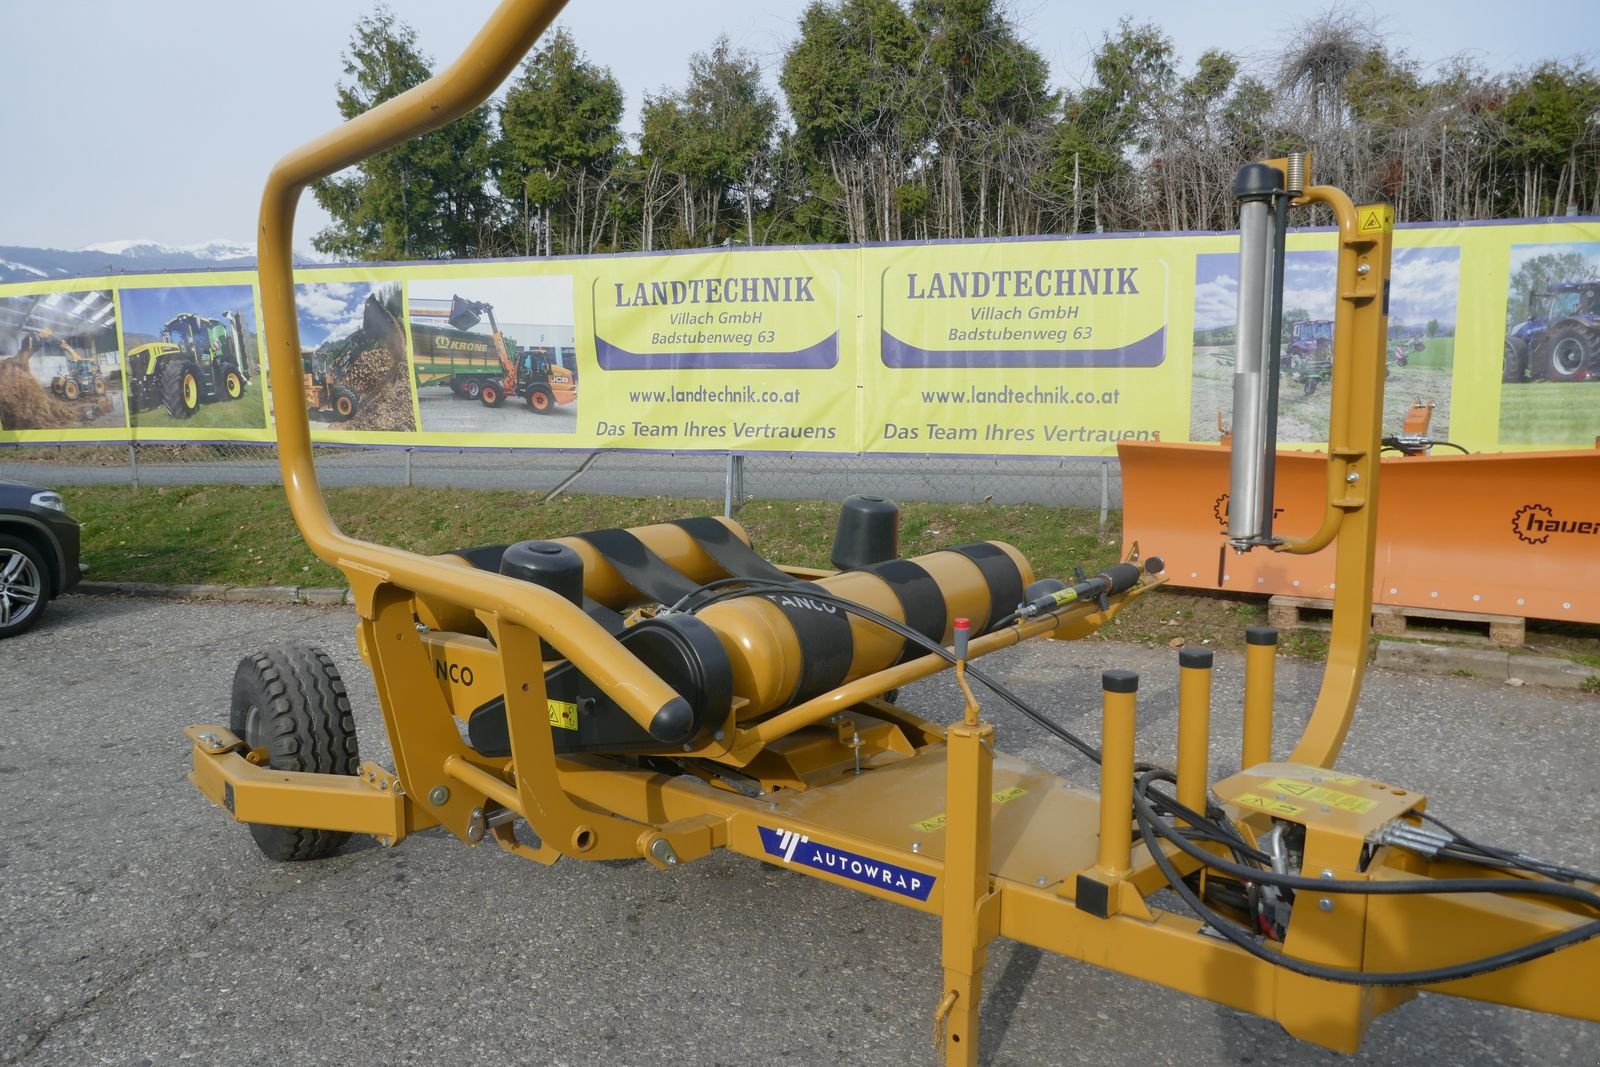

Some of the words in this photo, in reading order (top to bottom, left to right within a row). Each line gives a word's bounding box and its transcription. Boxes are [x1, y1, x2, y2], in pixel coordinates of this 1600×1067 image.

[614, 276, 815, 307] LANDTECHNIK
[907, 268, 1139, 299] LANDTECHNIK
[670, 312, 714, 326] Villach
[718, 311, 763, 324] GmbH
[970, 306, 1022, 321] Villach
[1027, 305, 1079, 320] GmbH
[651, 331, 753, 346] Badstubenweg
[757, 330, 776, 344] 63
[948, 327, 1067, 344] Badstubenweg
[1072, 326, 1093, 340] 63
[450, 340, 488, 353] KRONE
[629, 384, 800, 403] www.landtechnik.co.at
[921, 384, 1120, 404] www.landtechnik.co.at
[596, 421, 625, 437] Das
[632, 421, 678, 437] Team
[684, 421, 727, 438] Ihres
[733, 421, 837, 439] Vertrauens
[883, 423, 919, 440] Das
[926, 423, 978, 441] Team
[984, 424, 1035, 442] Ihres
[1043, 425, 1160, 443] Vertrauens
[812, 849, 921, 891] AUTOWRAP
